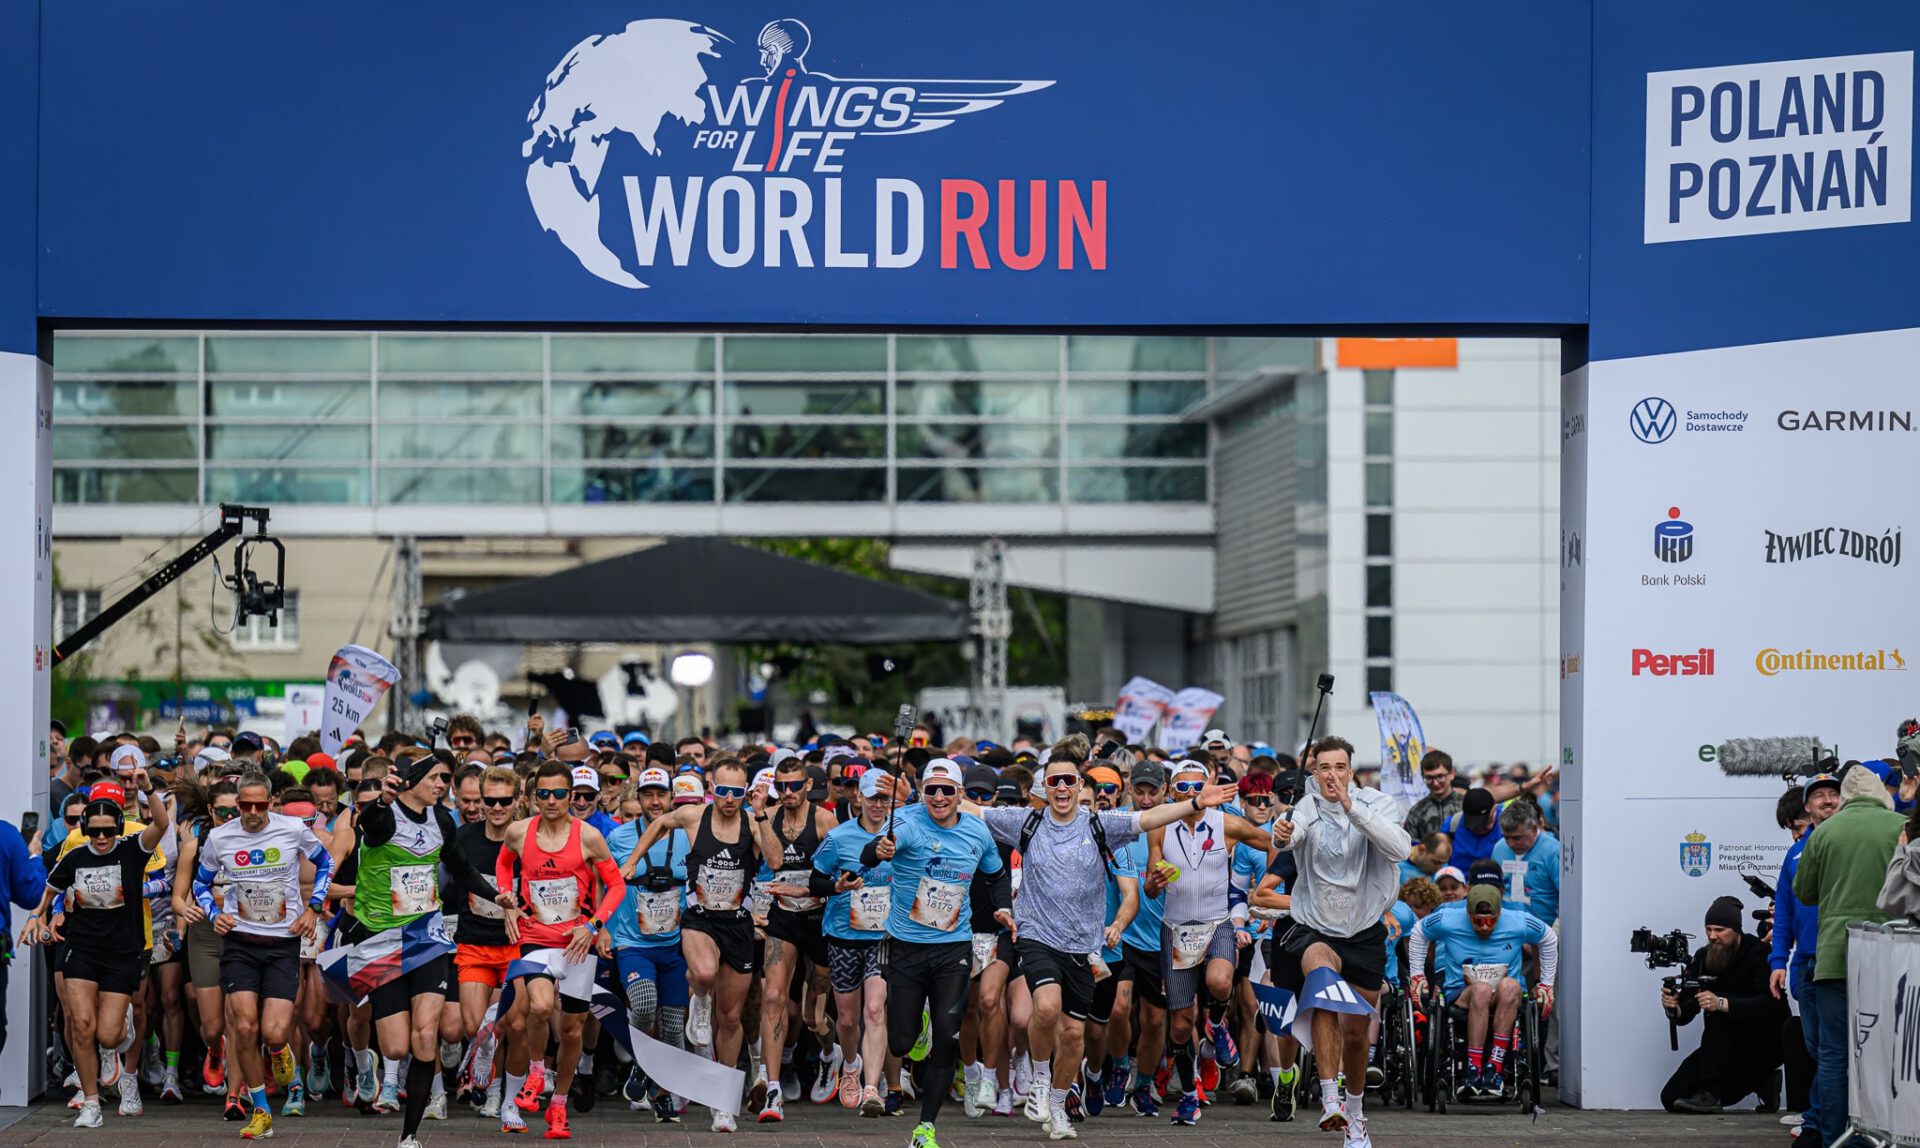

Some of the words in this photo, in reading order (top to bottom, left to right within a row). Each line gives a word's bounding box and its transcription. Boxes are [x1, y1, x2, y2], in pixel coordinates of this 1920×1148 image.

[1670, 70, 1885, 147] POLAND
[693, 131, 735, 149] FOR
[732, 131, 855, 172] LIFE
[1668, 131, 1888, 224] POZNAŃ
[622, 175, 925, 268] WORLD
[940, 179, 1107, 270] RUN
[1686, 410, 1749, 422] Samochody
[1686, 422, 1744, 432] Dostawcze
[1838, 525, 1902, 567] ZDRÓJ
[1641, 574, 1670, 586] Bank
[1673, 574, 1707, 586] Polski
[1631, 648, 1715, 676] Persil
[1755, 648, 1886, 676] Continental
[331, 697, 344, 715] 25
[345, 703, 360, 724] km
[1718, 863, 1746, 871] Miasta
[932, 868, 959, 880] WORLD
[87, 883, 111, 893] 18232
[404, 884, 429, 895] 17547
[542, 896, 569, 906] 17874
[926, 899, 954, 913] 18179
[862, 903, 887, 913] 14437
